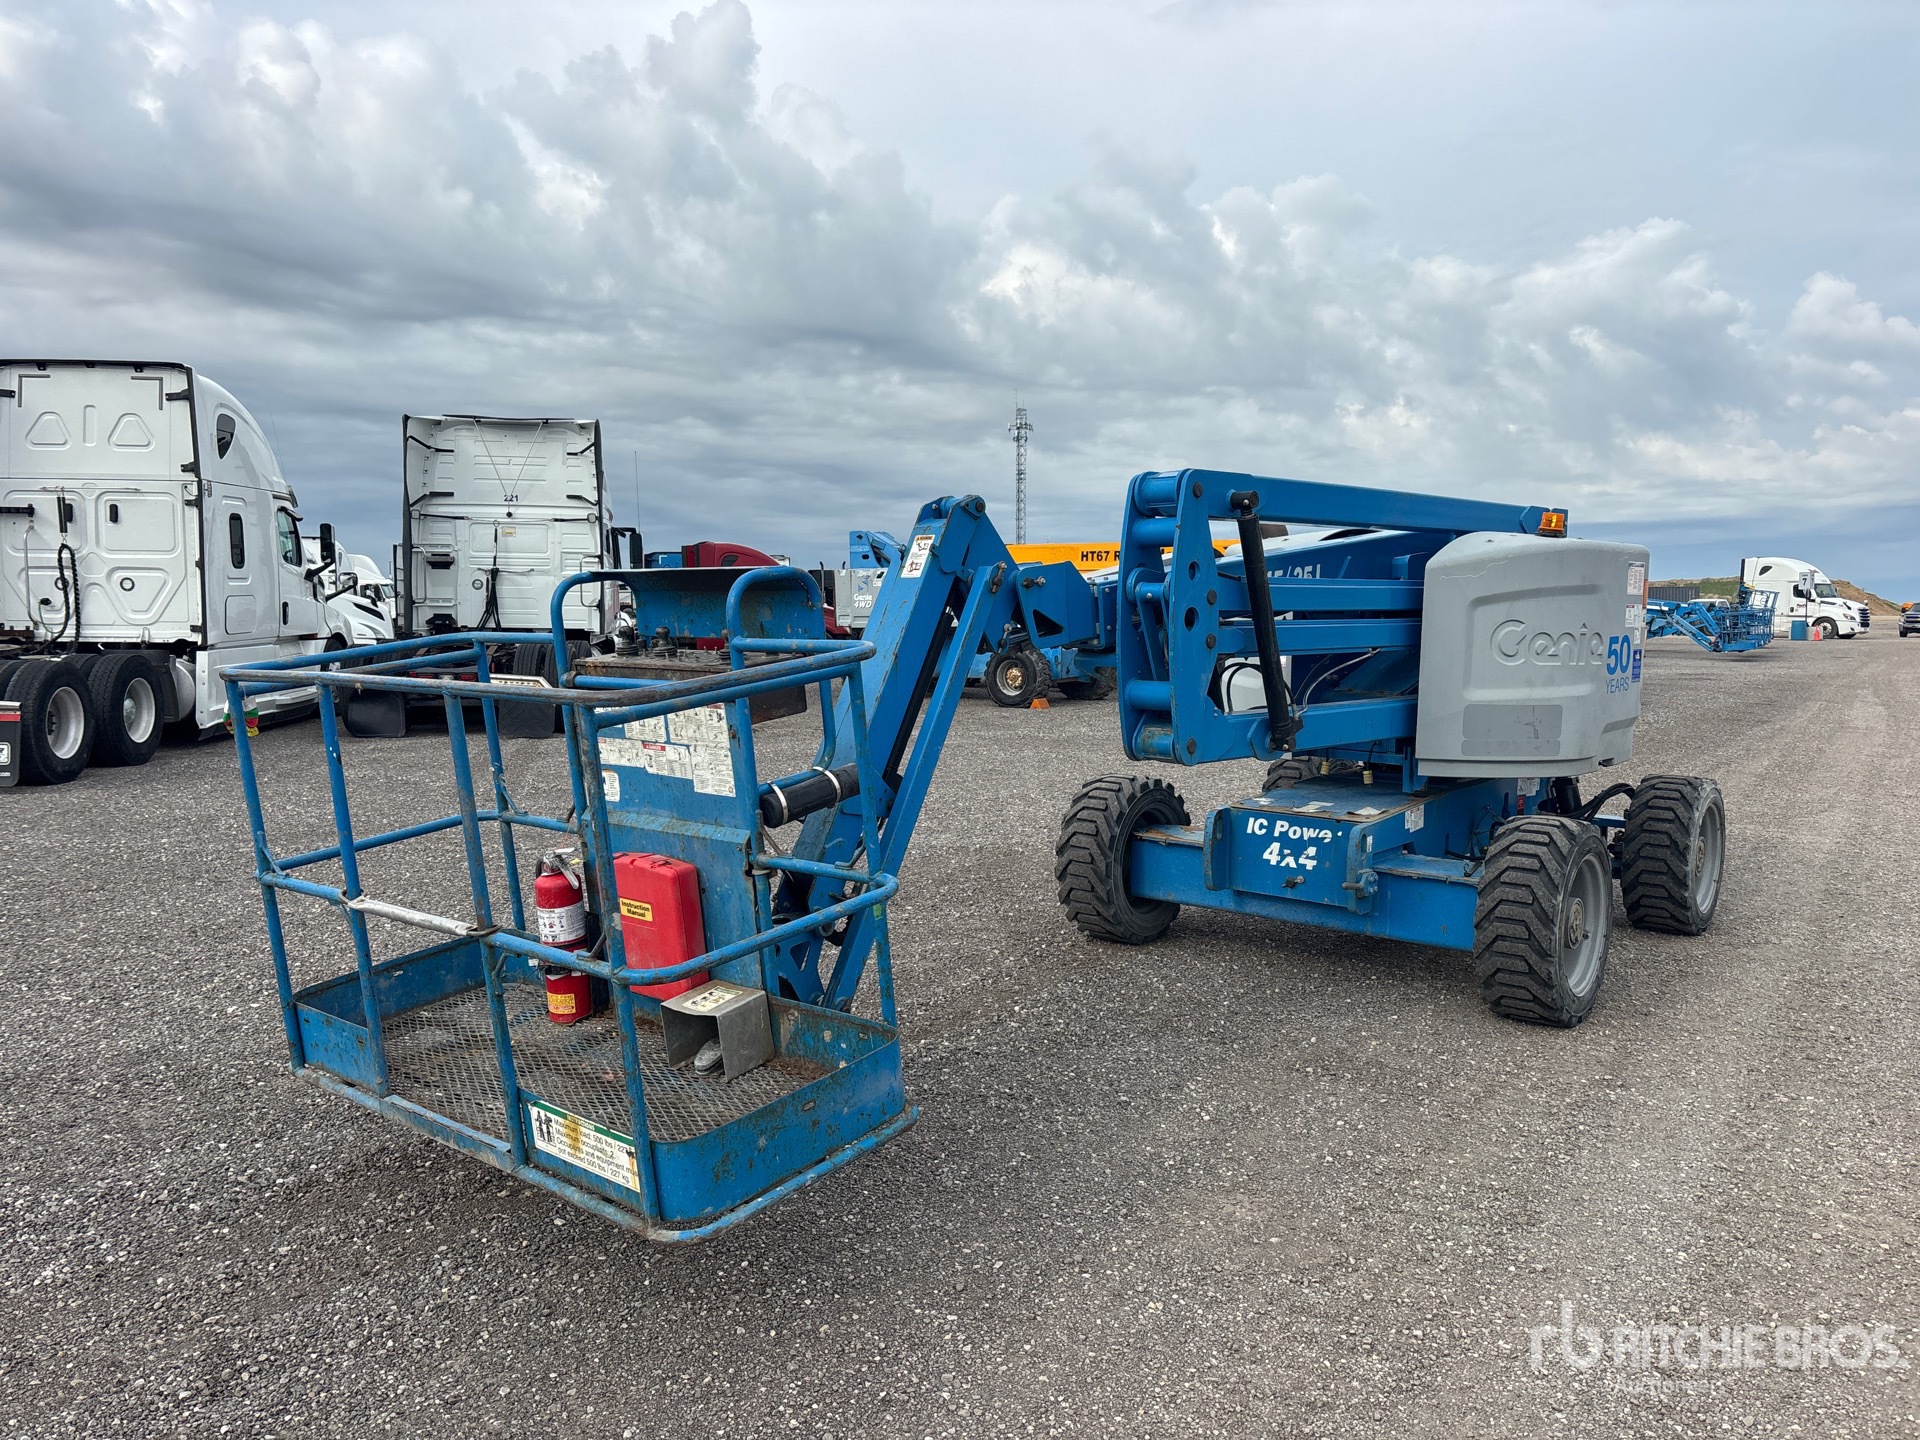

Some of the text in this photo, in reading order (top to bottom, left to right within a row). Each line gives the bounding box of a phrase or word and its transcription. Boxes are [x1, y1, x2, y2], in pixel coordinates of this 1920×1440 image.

[1081, 551, 1110, 561] HT67
[1802, 577, 1808, 586] 7
[854, 593, 872, 601] Genie
[854, 601, 872, 609] 4WD
[1490, 619, 1604, 666] Genie
[1606, 634, 1631, 675] 50
[1606, 677, 1630, 694] YEARS
[1246, 817, 1343, 843] IC Powe
[1262, 842, 1318, 870] 4x4
[621, 900, 651, 912] Instruction
[627, 908, 646, 918] Manual
[592, 1134, 604, 1145] 500
[604, 1138, 613, 1149] lbs
[567, 1151, 586, 1164] exceed
[586, 1158, 597, 1169] 500
[597, 1162, 607, 1173] lbs
[610, 1168, 621, 1178] 227
[585, 1149, 595, 1159] and
[596, 1154, 625, 1172] equipment
